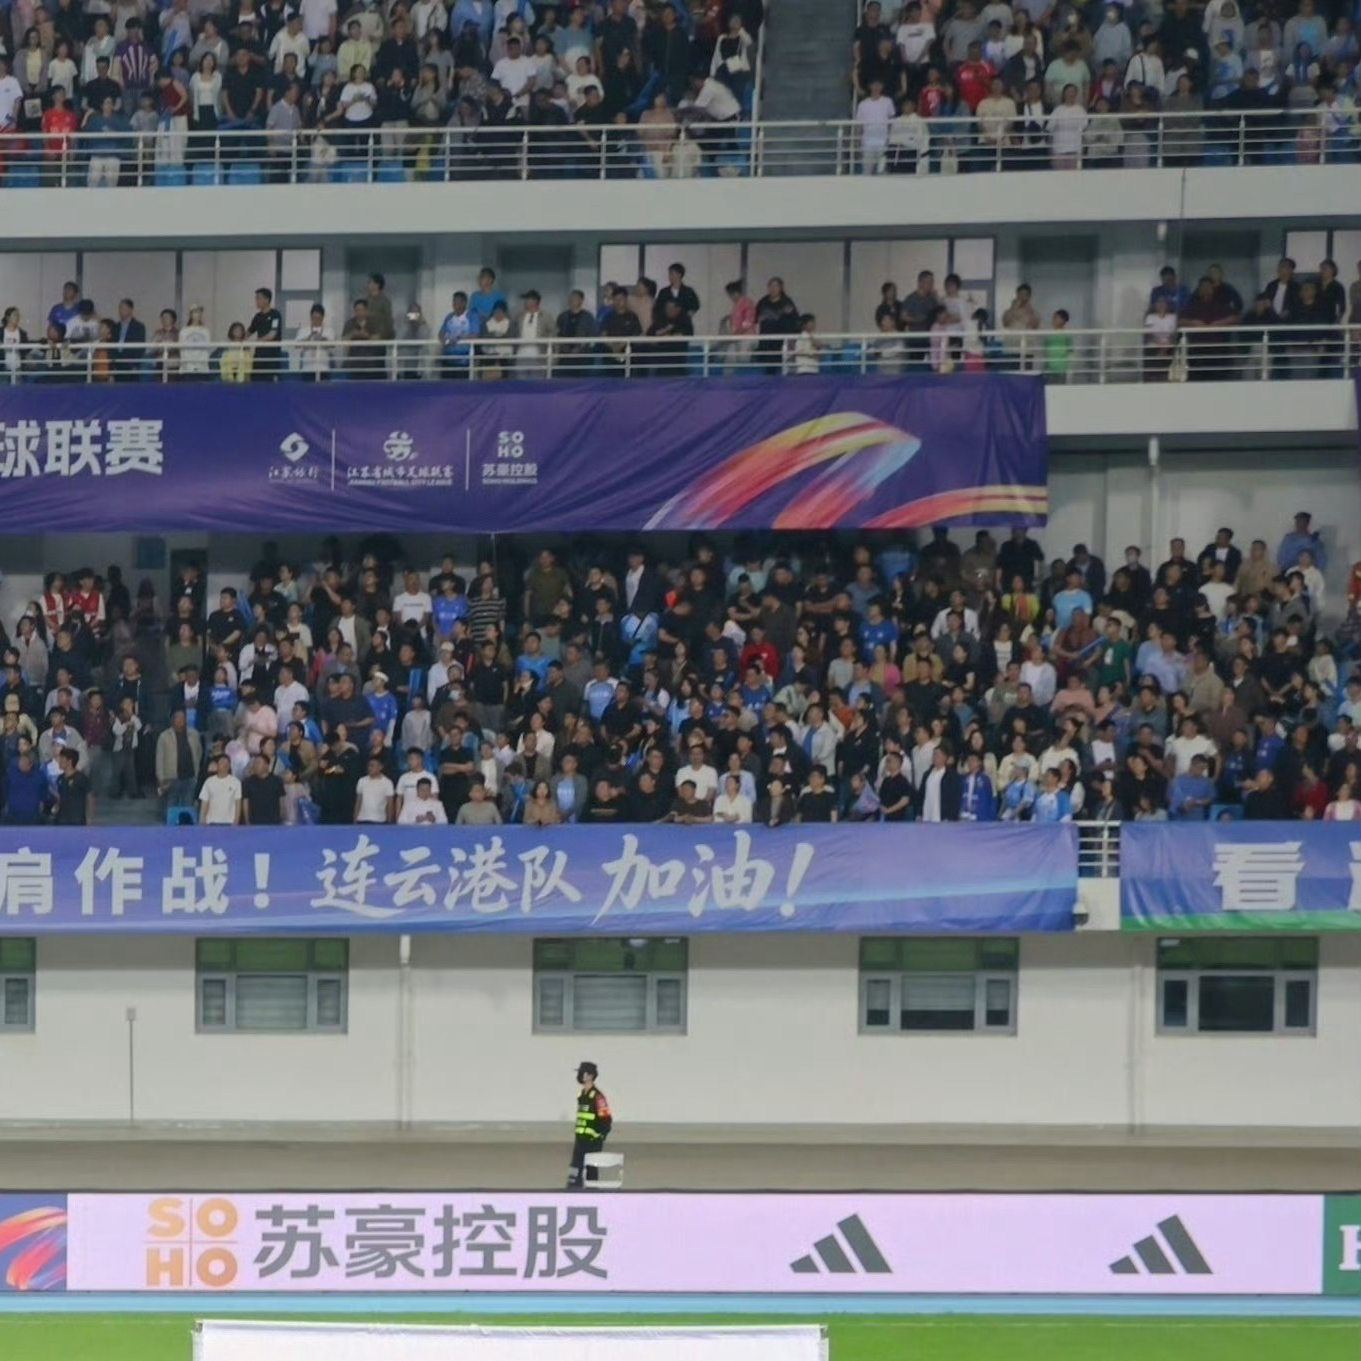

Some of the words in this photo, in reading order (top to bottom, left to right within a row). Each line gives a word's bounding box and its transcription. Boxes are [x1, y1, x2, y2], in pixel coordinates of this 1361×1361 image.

[311, 833, 583, 919] 连云港队
[144, 1196, 239, 1238] SO
[253, 1203, 609, 1280] 苏豪控股
